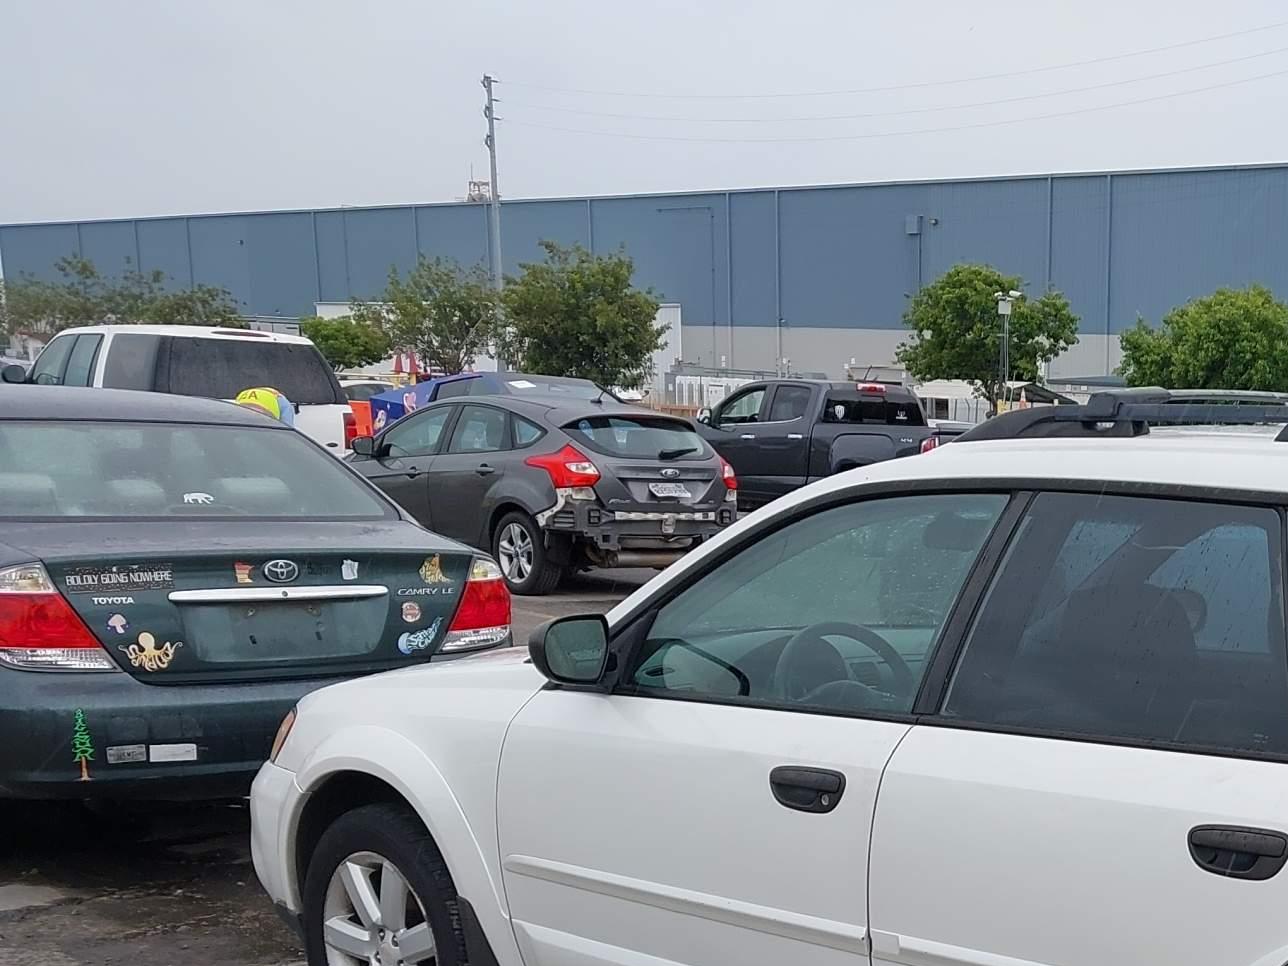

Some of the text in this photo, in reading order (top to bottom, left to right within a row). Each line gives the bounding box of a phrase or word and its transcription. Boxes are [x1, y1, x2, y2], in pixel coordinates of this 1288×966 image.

[65, 570, 173, 586] BOLDLY GOING NOWHERE
[397, 587, 456, 596] CAMRY LE
[91, 597, 135, 605] TOYOTA
